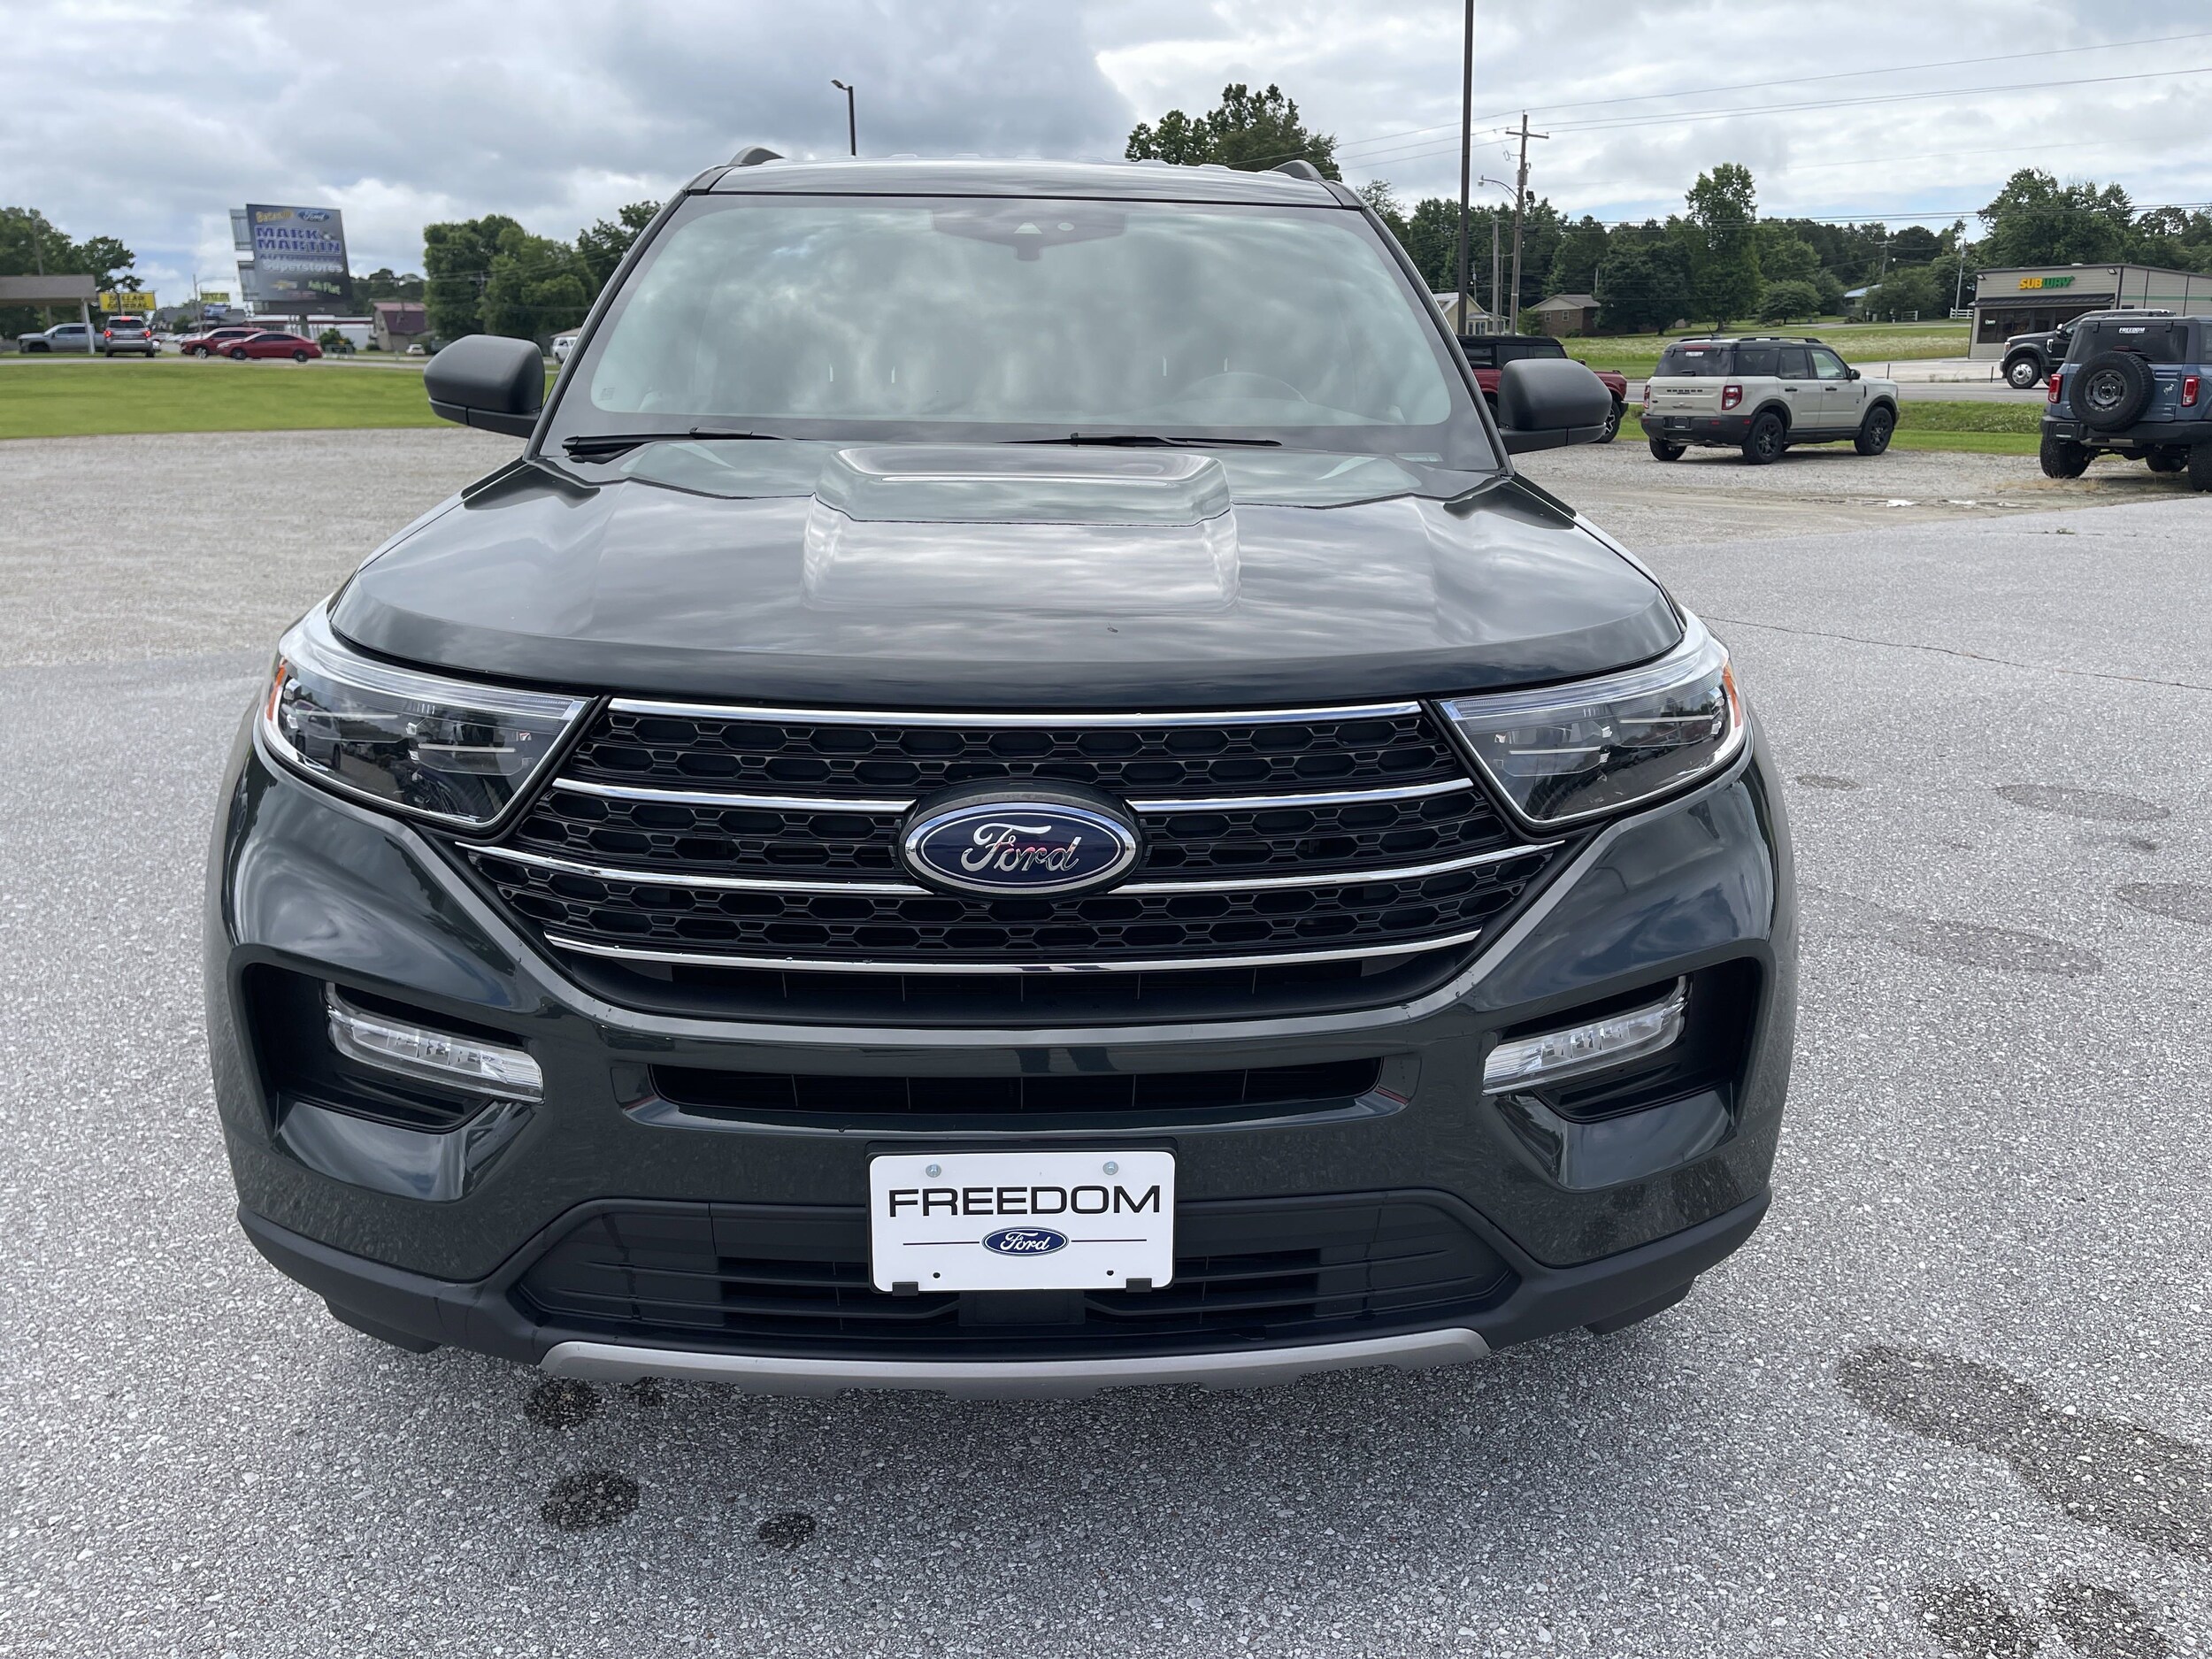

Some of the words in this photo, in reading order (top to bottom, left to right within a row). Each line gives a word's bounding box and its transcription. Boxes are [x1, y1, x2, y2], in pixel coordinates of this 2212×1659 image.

[256, 227, 319, 239] MARK
[257, 238, 341, 252] MARTIN
[262, 259, 344, 273] Superstores
[2018, 276, 2076, 290] SUBWAY
[961, 822, 1081, 872] Ford
[888, 1185, 1161, 1217] FREEDOM
[1000, 1232, 1050, 1251] Ford
